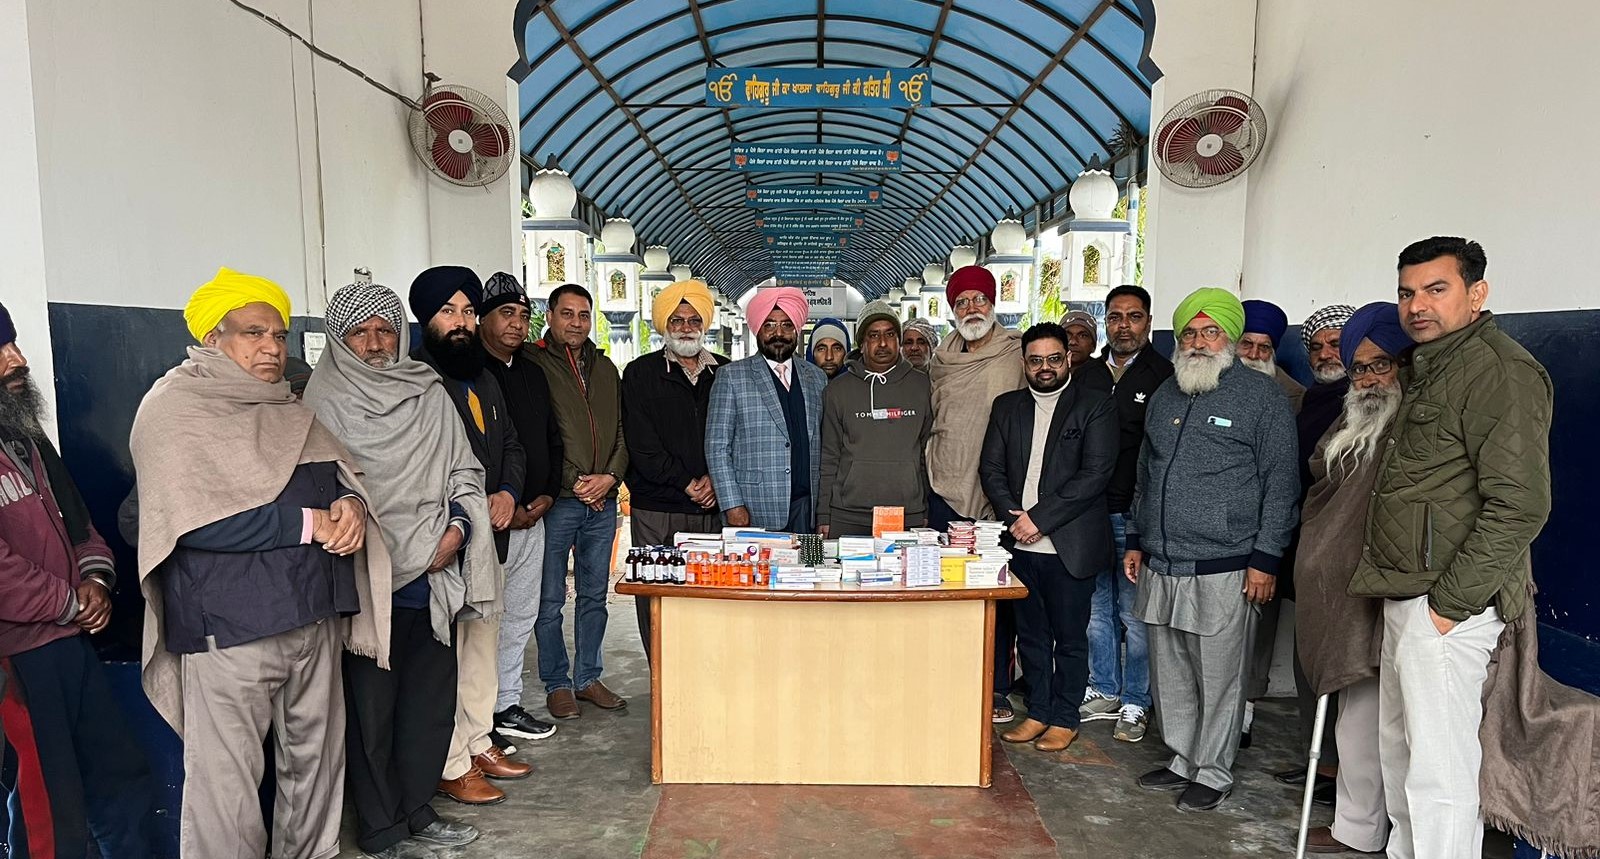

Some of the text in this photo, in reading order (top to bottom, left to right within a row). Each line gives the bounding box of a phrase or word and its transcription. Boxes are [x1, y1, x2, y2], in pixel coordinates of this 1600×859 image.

[772, 77, 780, 97] ਜੀ
[781, 82, 790, 95] ਕਾ
[842, 79, 851, 95] ਜੀ
